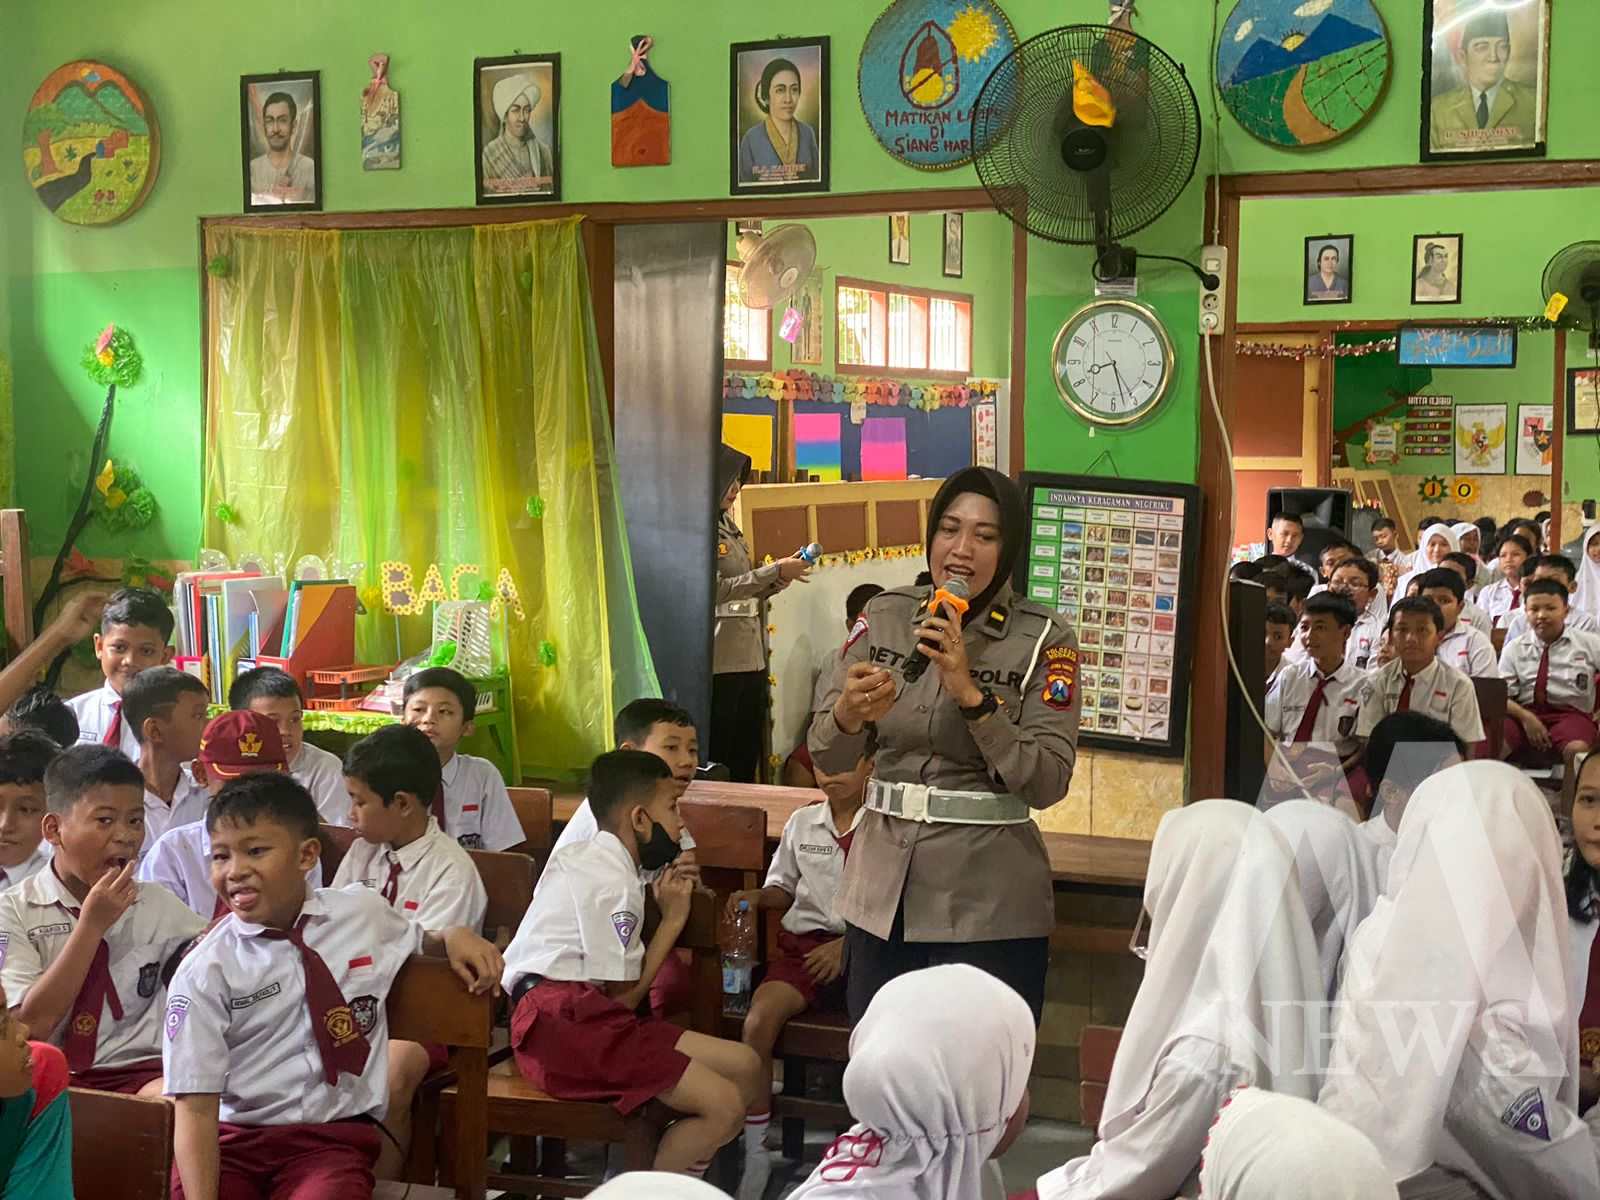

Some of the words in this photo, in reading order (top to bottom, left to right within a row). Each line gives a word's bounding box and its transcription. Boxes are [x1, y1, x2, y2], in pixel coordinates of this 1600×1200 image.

[885, 109, 951, 127] MATIKAN
[930, 121, 944, 140] DI
[943, 139, 974, 153] HAR
[1111, 313, 1119, 329] 12
[1142, 337, 1156, 346] 2
[1072, 378, 1086, 388] 8
[1142, 379, 1155, 389] 4
[1110, 397, 1117, 412] 6
[1050, 493, 1086, 505] INDAHNYA
[1088, 496, 1131, 507] KERAGAMAN
[1135, 499, 1170, 511] NEGERIKU
